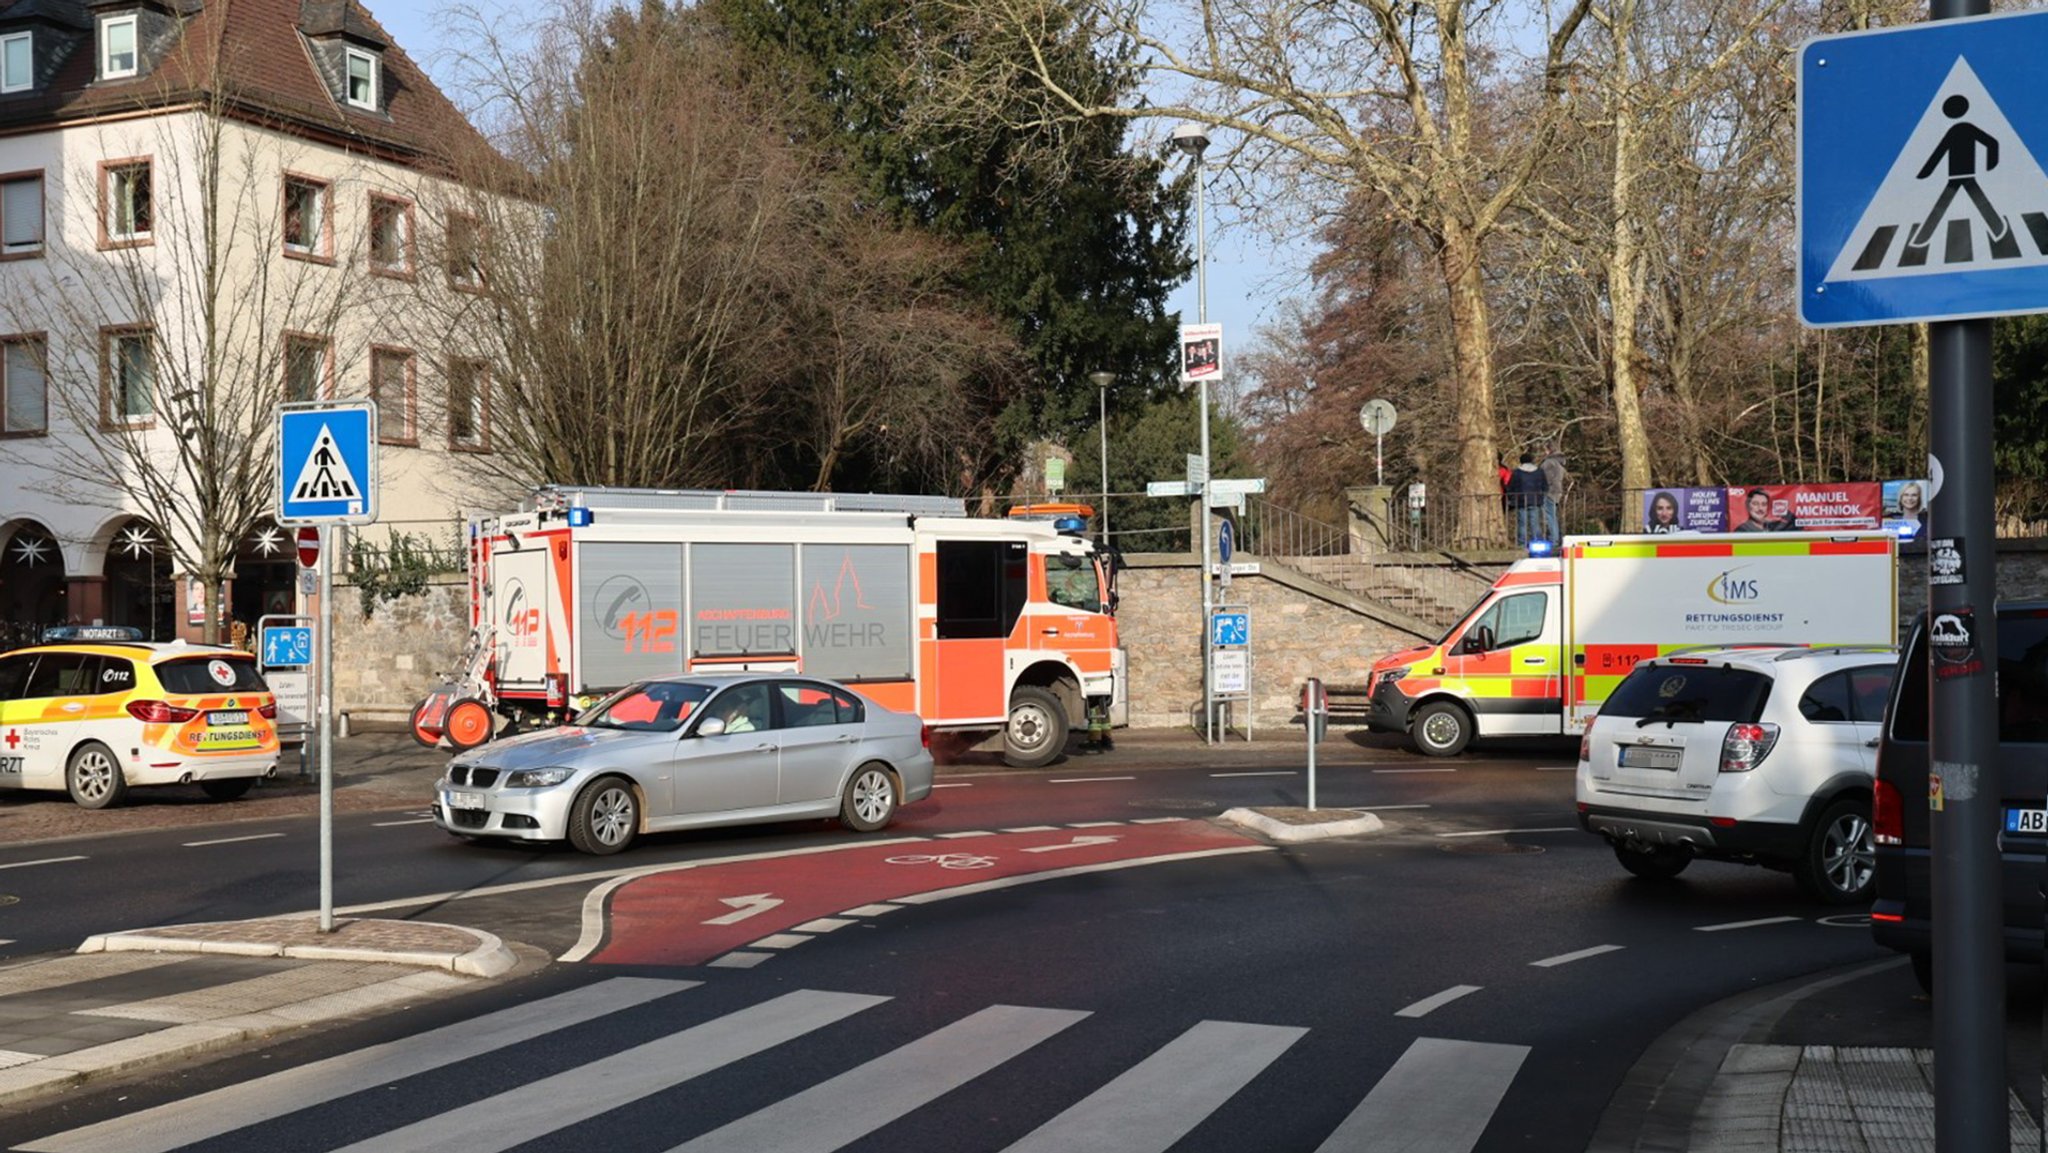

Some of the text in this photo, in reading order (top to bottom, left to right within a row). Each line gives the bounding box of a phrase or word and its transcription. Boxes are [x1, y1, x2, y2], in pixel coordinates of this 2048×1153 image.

[1795, 492, 1849, 502] MANUEL
[1795, 504, 1861, 516] MICHNIOK
[1685, 613, 1785, 622] RETTUNGSDIENST
[512, 608, 540, 647] 112
[617, 609, 678, 653] 112
[1755, 623, 1784, 631] GROUP
[82, 628, 118, 639] NOTARZT
[697, 622, 886, 650] FEUER WEHR
[1617, 654, 1640, 667] 112
[113, 671, 130, 681] 112
[2020, 812, 2044, 830] AB
